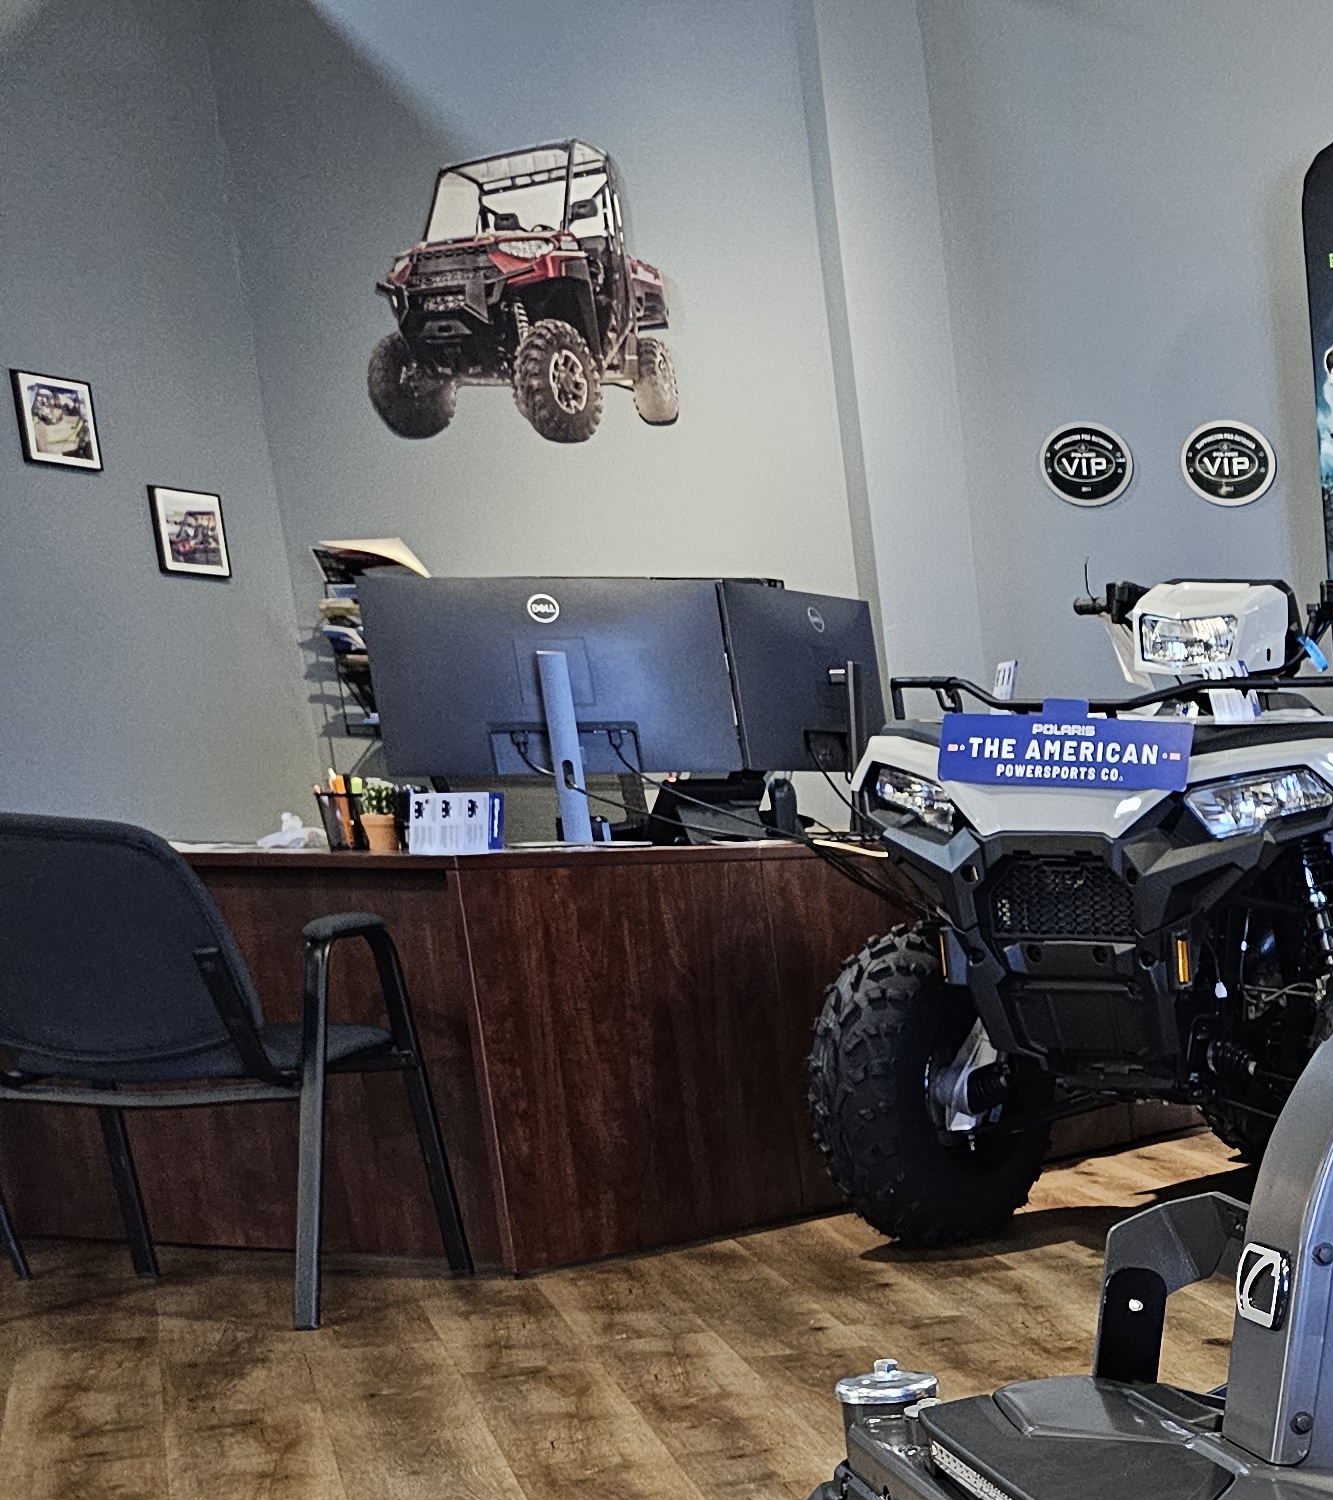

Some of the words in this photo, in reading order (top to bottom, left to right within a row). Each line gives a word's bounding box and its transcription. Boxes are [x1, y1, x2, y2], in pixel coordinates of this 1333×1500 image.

[1061, 457, 1107, 476] VIP
[1203, 456, 1250, 476] VIP
[1032, 723, 1096, 736] POLARIS
[969, 736, 1017, 758] THE
[1024, 740, 1159, 765] AMERICAN
[996, 764, 1096, 781] POWERSPORTS
